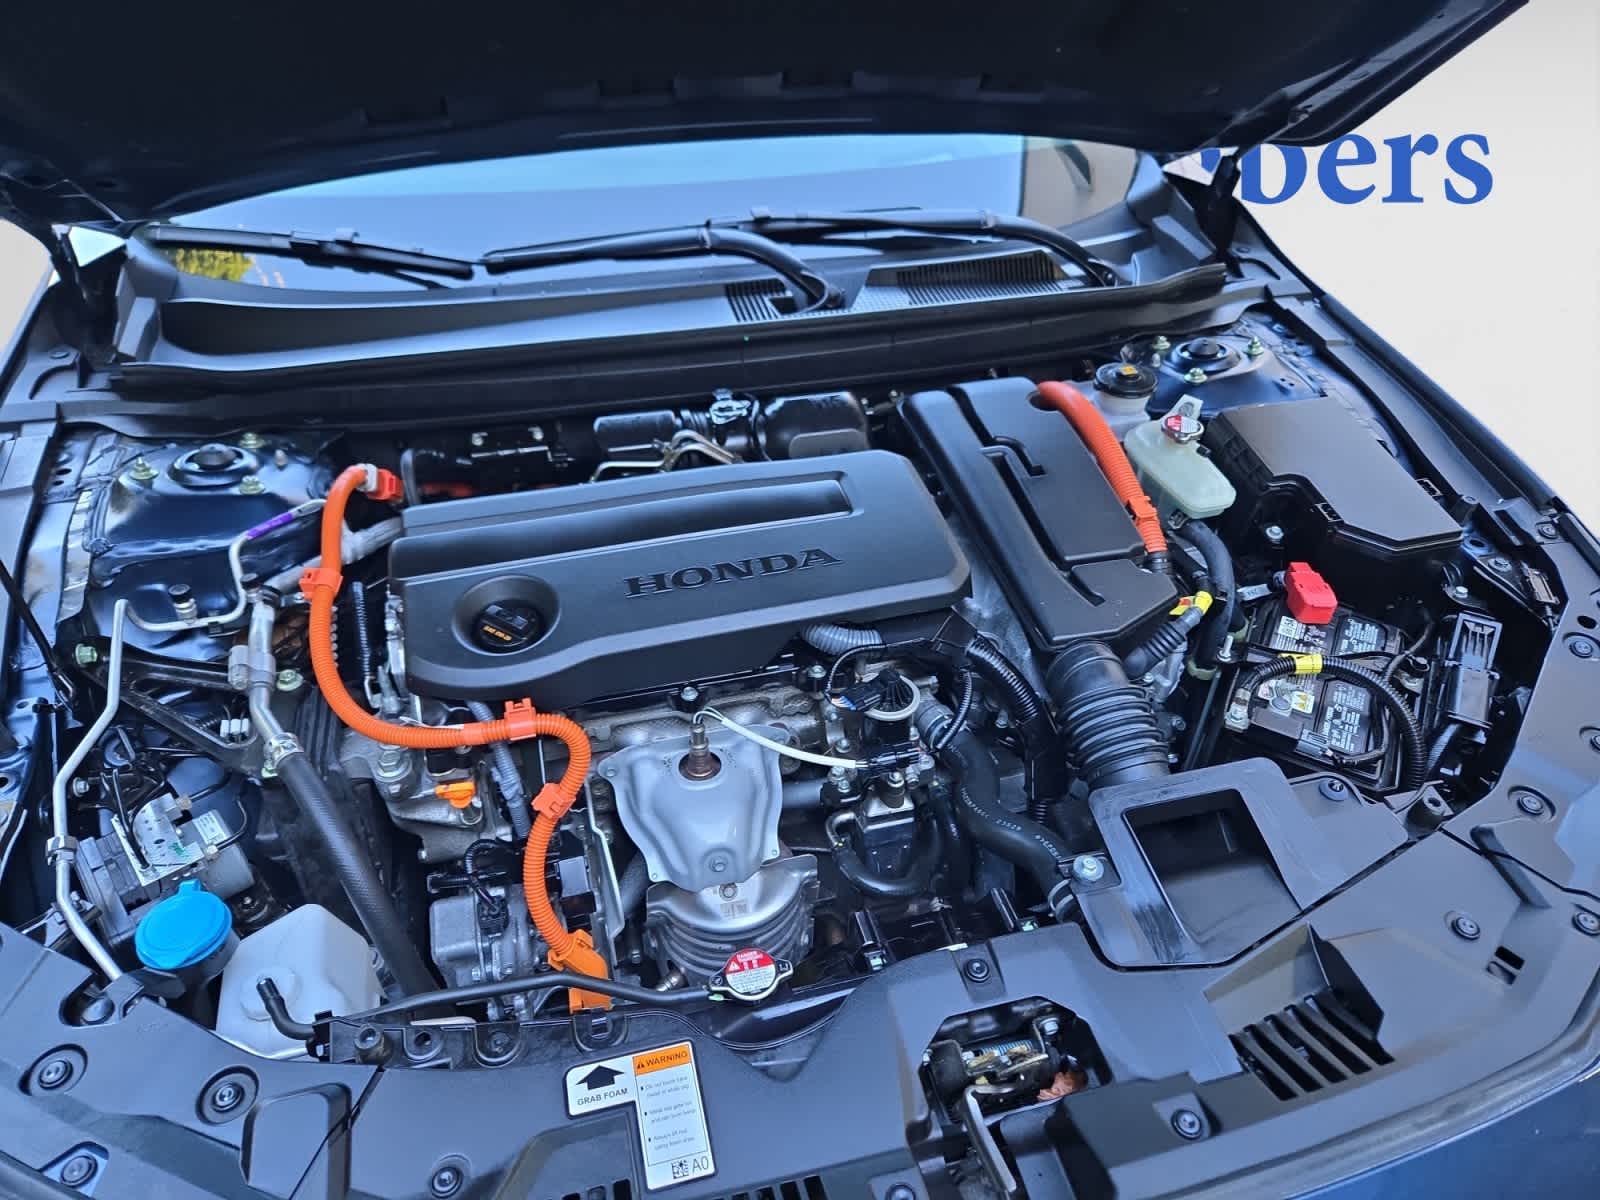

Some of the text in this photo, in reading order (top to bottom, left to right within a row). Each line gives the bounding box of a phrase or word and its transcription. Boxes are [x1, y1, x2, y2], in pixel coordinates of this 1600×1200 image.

[624, 548, 843, 599] HONDA
[646, 1050, 688, 1067] WARNING
[577, 1087, 628, 1106] GRAB FOAM
